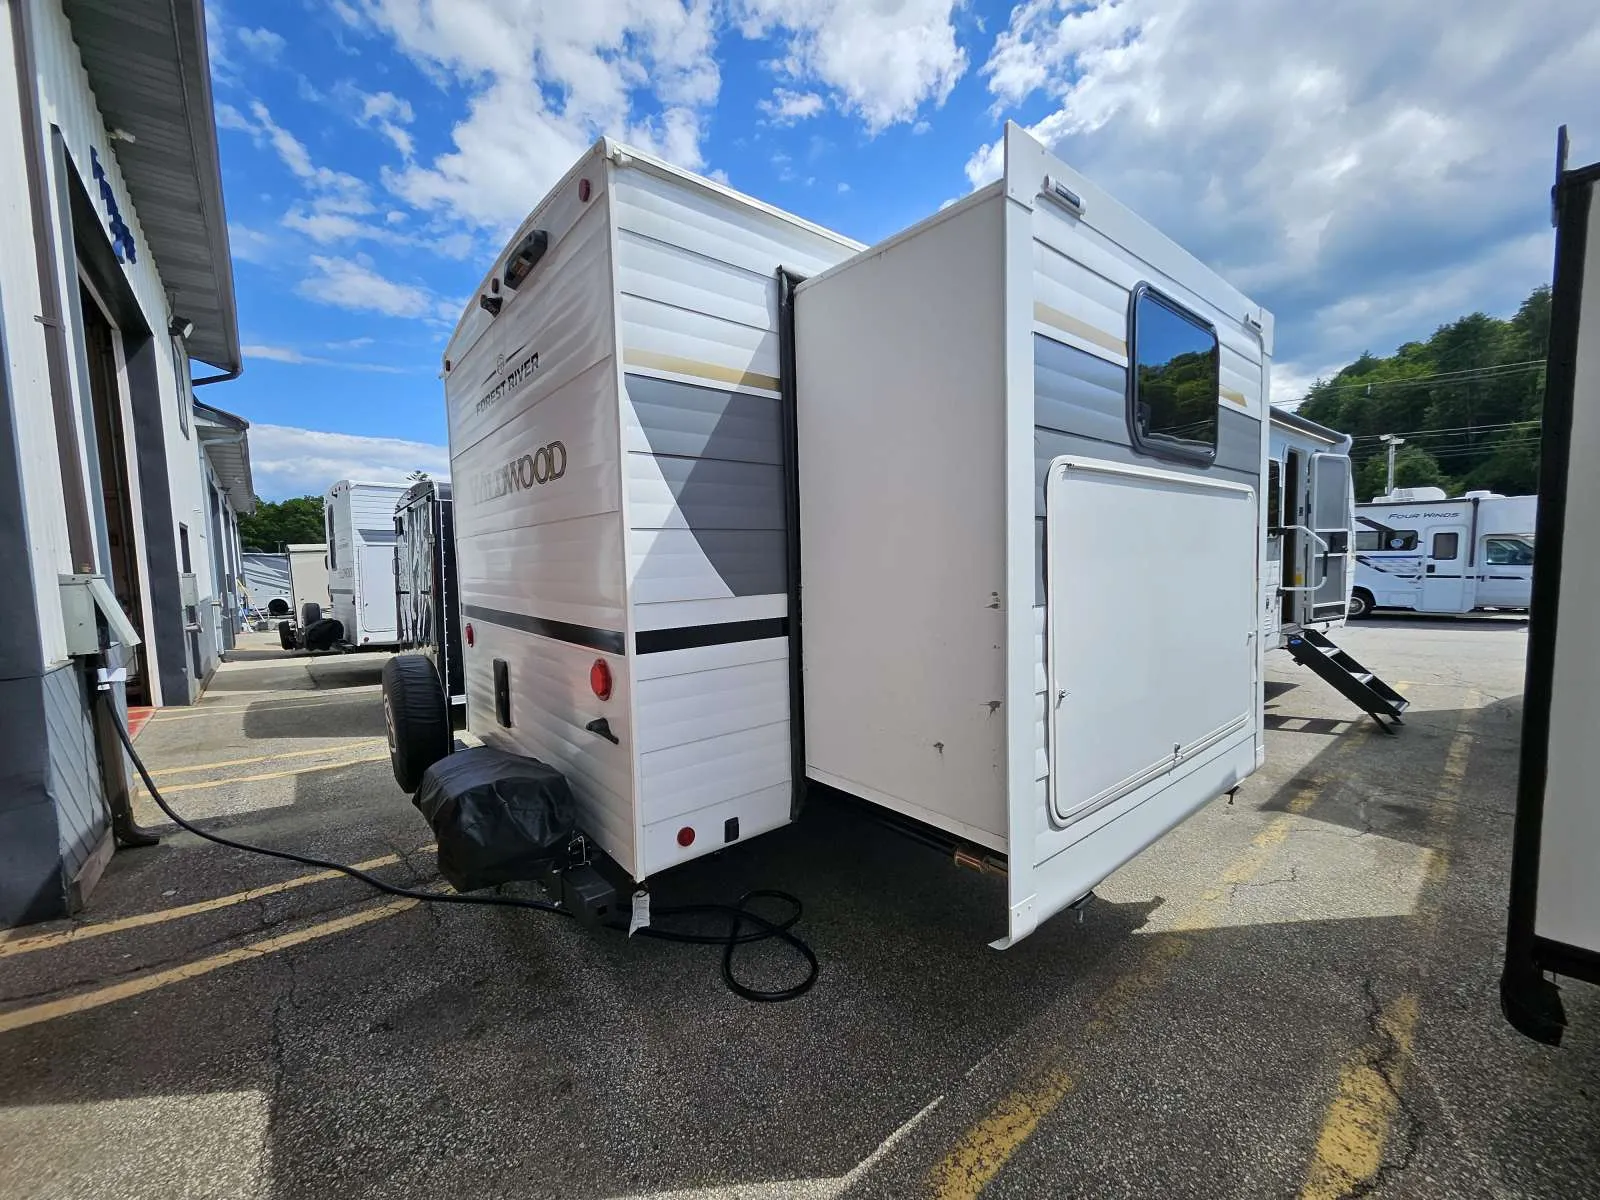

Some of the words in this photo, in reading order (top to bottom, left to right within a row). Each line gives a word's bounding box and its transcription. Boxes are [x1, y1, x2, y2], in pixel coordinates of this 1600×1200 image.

[475, 379, 506, 416] FOREST
[507, 351, 539, 391] RIVER
[470, 440, 567, 505] DWOOD
[1388, 512, 1421, 520] FOUR
